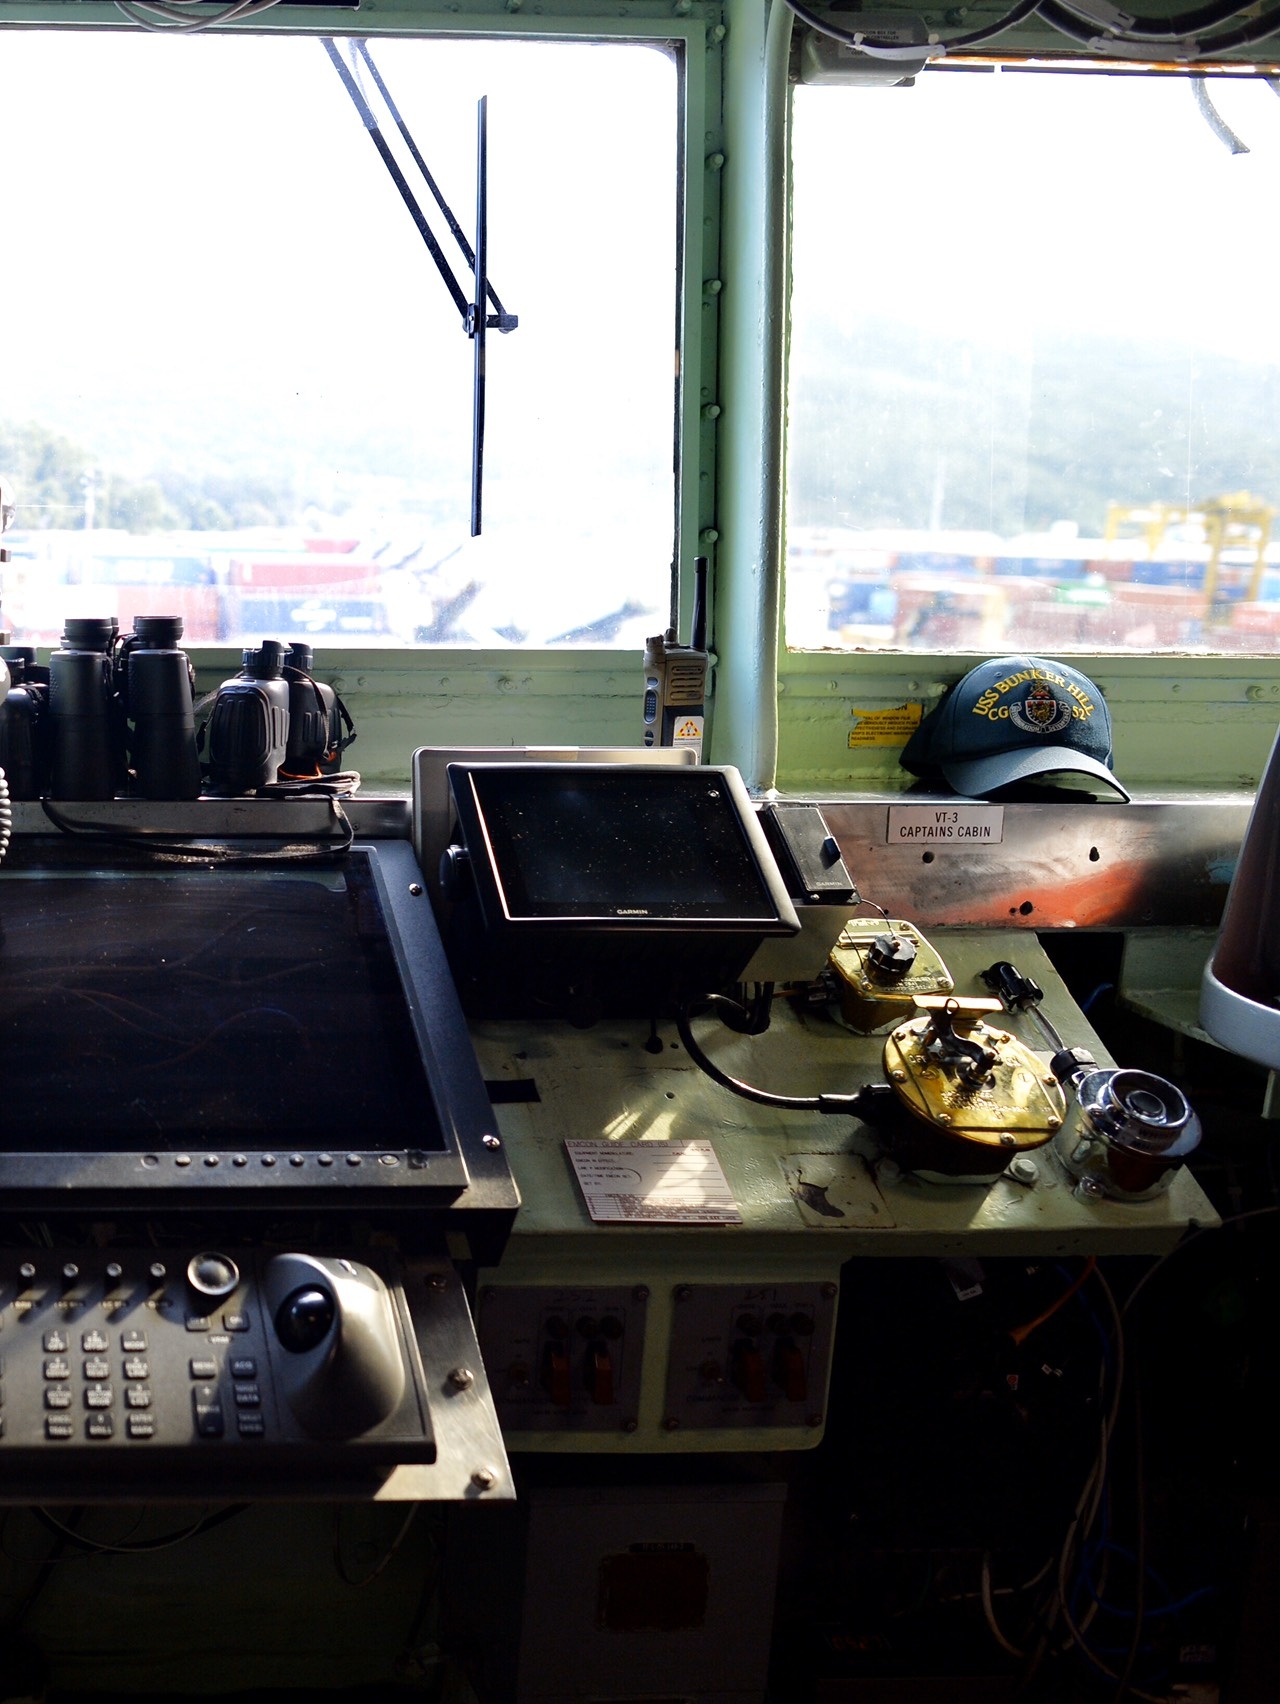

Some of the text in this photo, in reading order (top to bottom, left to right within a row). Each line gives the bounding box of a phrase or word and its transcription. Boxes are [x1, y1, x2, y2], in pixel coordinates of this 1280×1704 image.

[972, 669, 1095, 717] USS BUNKER HILL
[988, 705, 1087, 721] CG 52
[935, 812, 959, 824] VT-3
[900, 826, 991, 838] CAPTAINS CABIN
